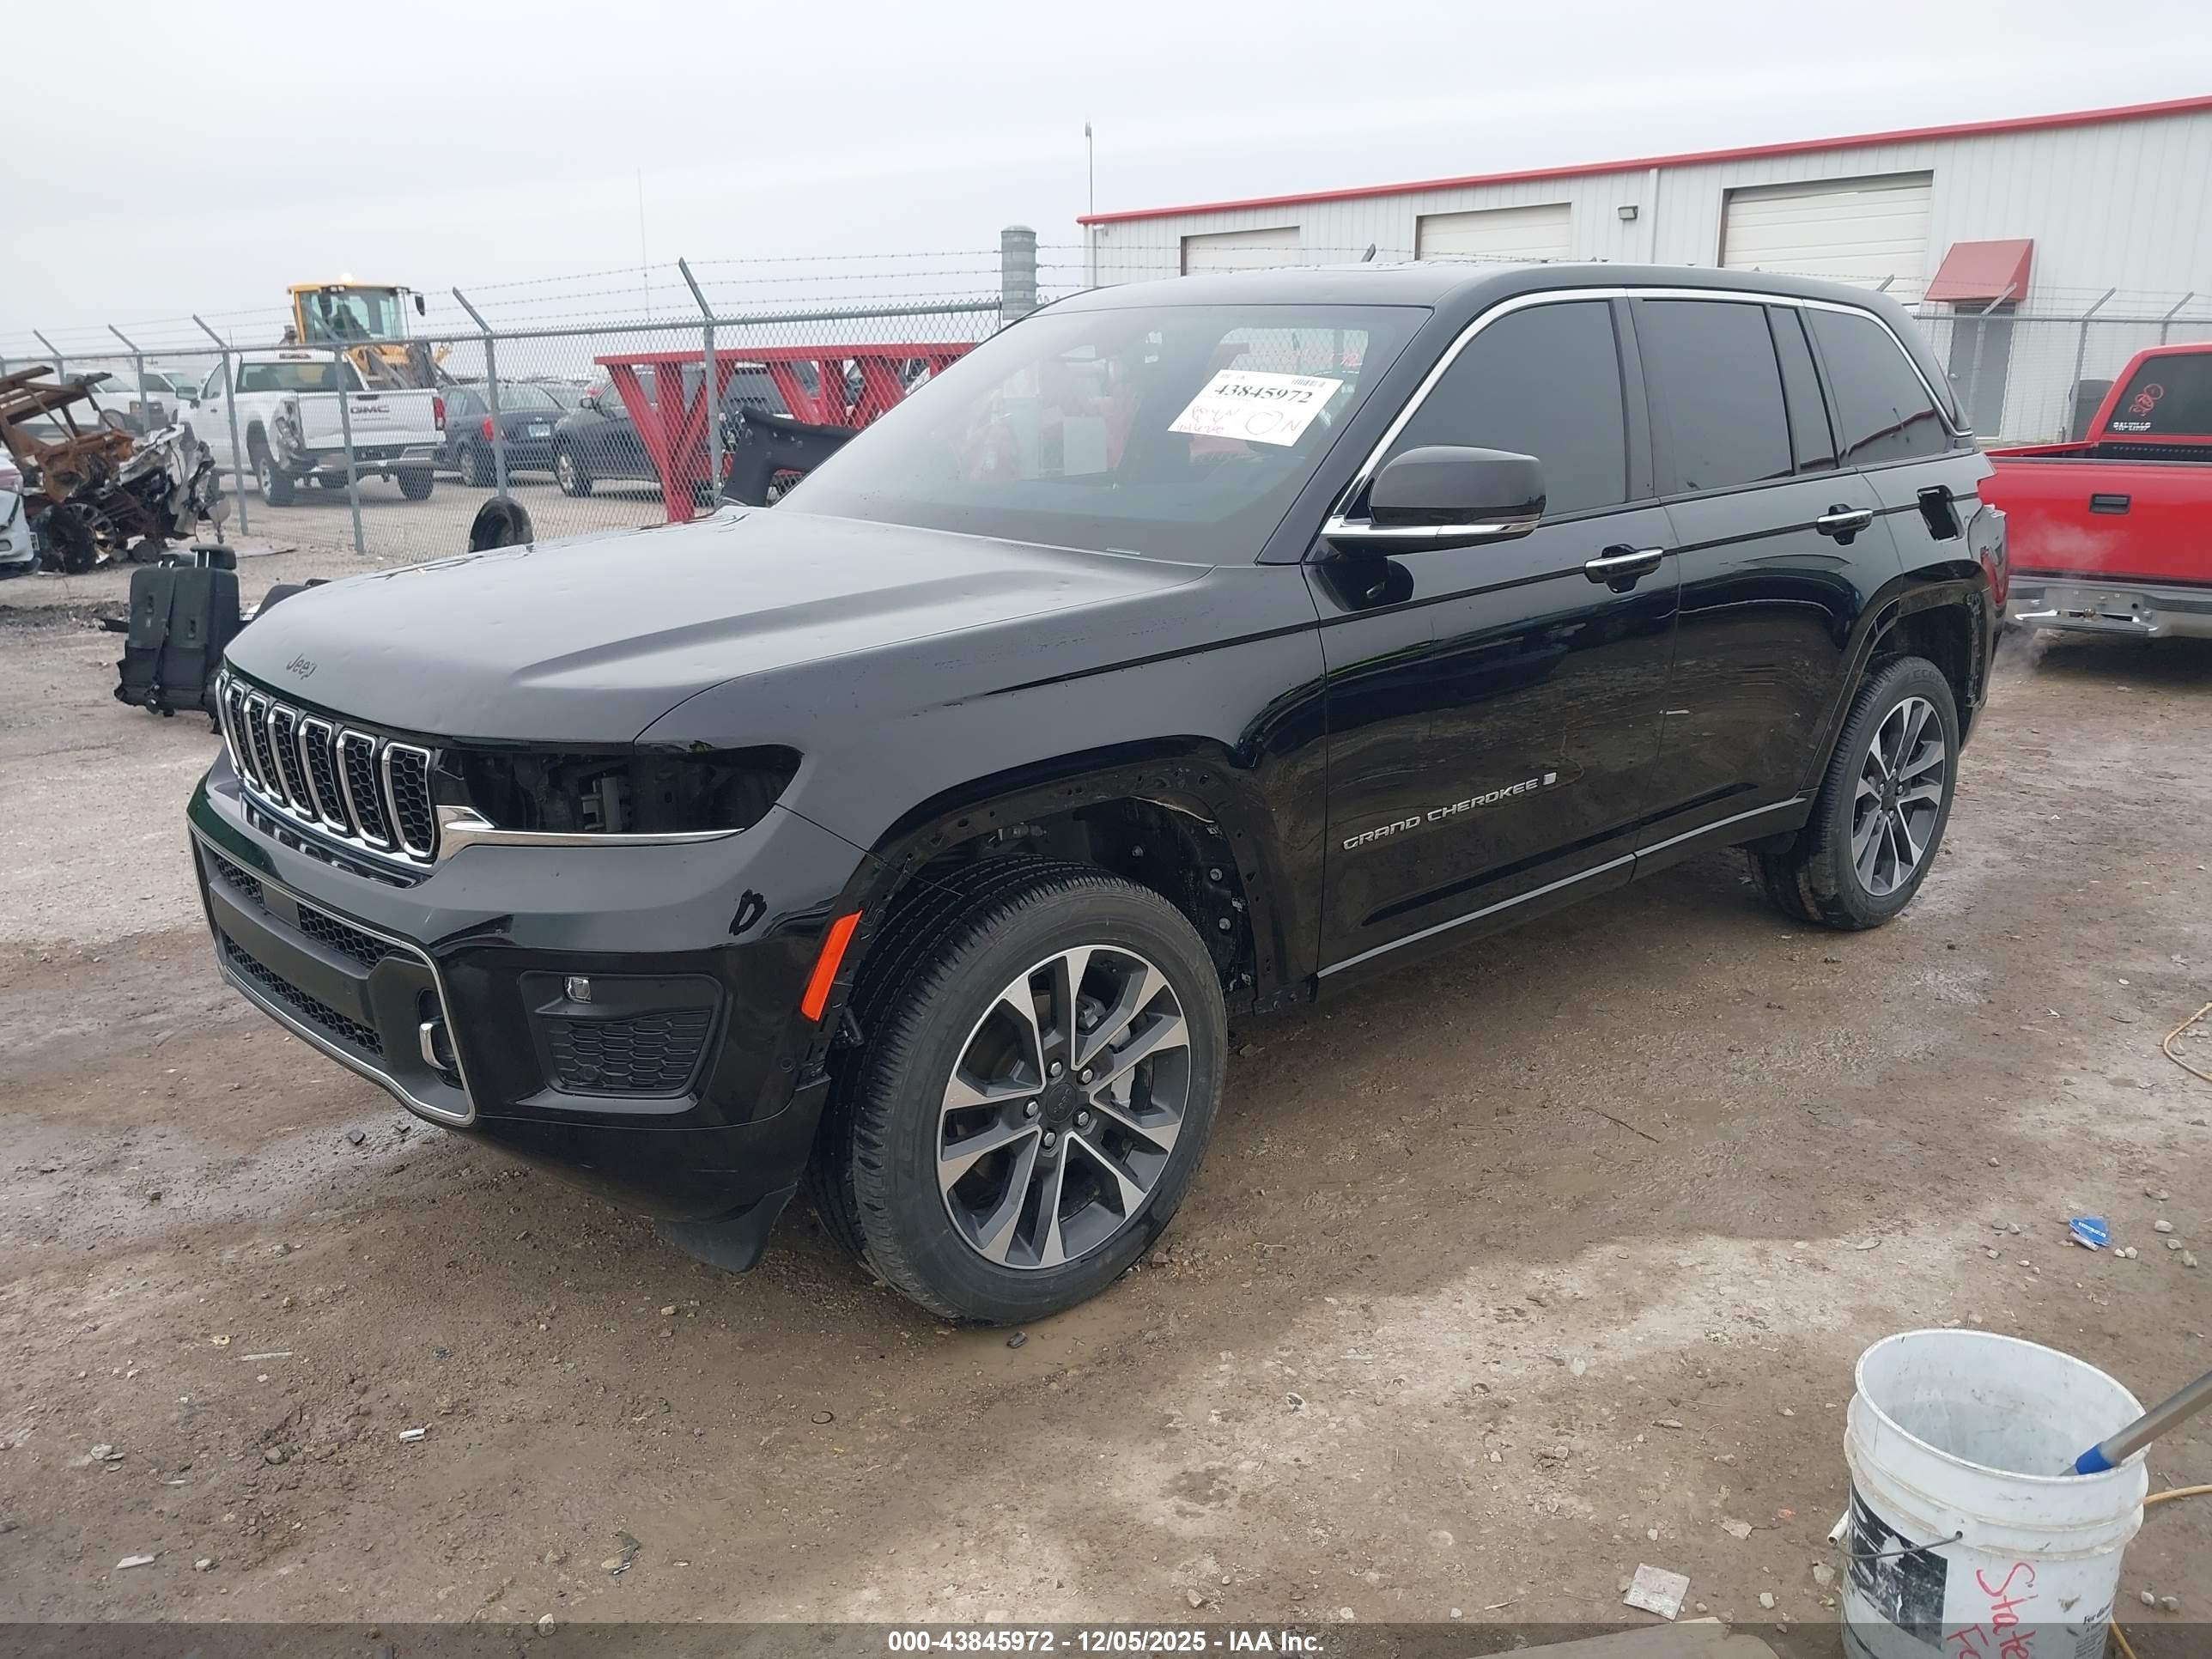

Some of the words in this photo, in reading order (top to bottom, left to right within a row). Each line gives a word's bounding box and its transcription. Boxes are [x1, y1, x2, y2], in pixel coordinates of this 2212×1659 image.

[1215, 384, 1313, 404] 43845972
[350, 405, 390, 414] GMC
[285, 653, 317, 680] Jeep
[1342, 816, 1421, 850] GRAND
[1427, 778, 1539, 822] CHEROKEE
